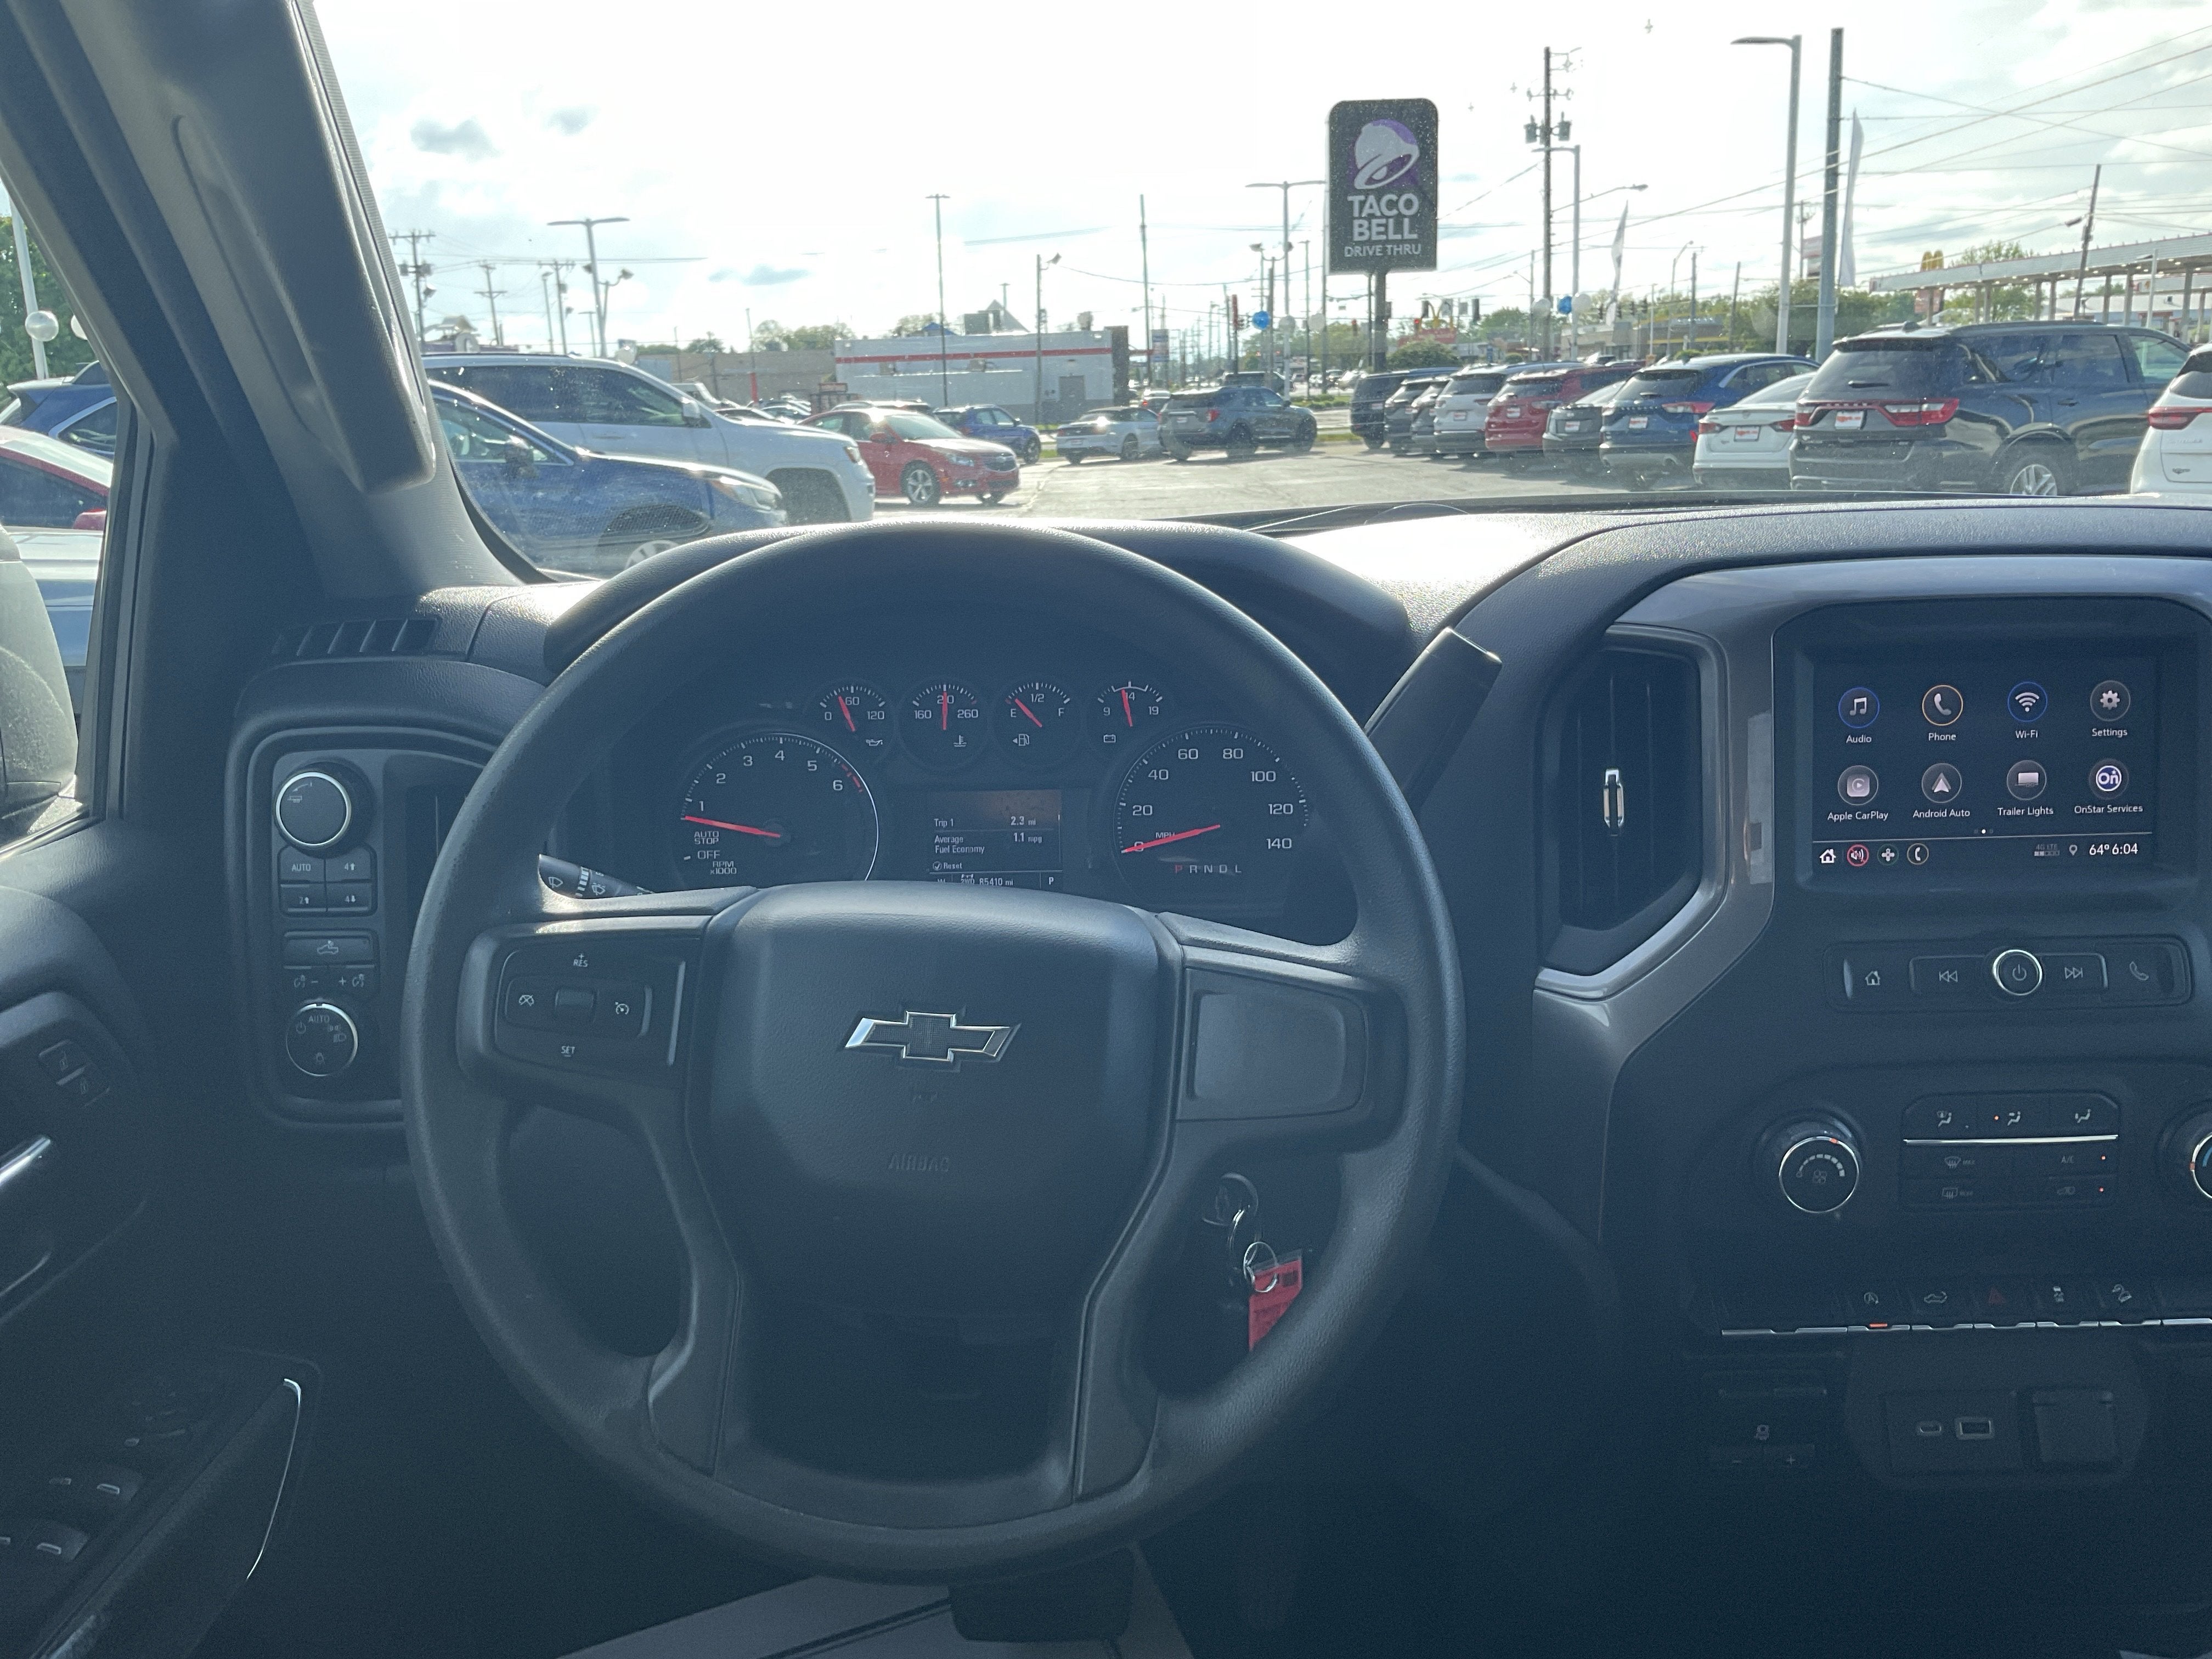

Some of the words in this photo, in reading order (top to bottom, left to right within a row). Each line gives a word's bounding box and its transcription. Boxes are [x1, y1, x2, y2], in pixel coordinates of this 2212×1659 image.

[1347, 193, 1419, 218] TACO
[1353, 218, 1418, 241] BELL
[1345, 246, 1383, 257] DRIVE
[1386, 244, 1421, 256] THRU
[845, 697, 860, 706] 60
[937, 695, 954, 704] 20
[1031, 693, 1045, 703] 1/2
[867, 711, 885, 720] 120
[914, 710, 932, 719] 160
[957, 709, 978, 718] 260
[1010, 709, 1016, 718] E
[1058, 708, 1064, 716] F
[1103, 707, 1110, 716] 9
[1148, 706, 1159, 715] 19
[825, 712, 832, 720] 0
[1928, 732, 1956, 741] Phone
[2015, 730, 2038, 738] Wi-Fi
[2092, 728, 2128, 738] Settings
[1846, 735, 1872, 743] Audio
[775, 750, 785, 761] 4
[1178, 749, 1199, 760] 60
[1222, 748, 1244, 759] 80
[743, 755, 753, 766] 3
[807, 760, 817, 771] 5
[716, 773, 726, 784] 2
[1148, 769, 1169, 780] 40
[1250, 771, 1276, 782] 100
[832, 780, 843, 791] 6
[699, 801, 704, 811] 1
[1132, 805, 1153, 816] 20
[1268, 803, 1294, 815] 120
[1997, 806, 2025, 816] Trailer
[2027, 806, 2054, 816] Lights
[2074, 805, 2104, 814] OnStar
[2107, 804, 2143, 813] Services
[1827, 812, 1853, 822] Apple
[1855, 811, 1889, 821] CarPlay
[1912, 809, 1947, 818] Android
[1949, 809, 1971, 817] Auto
[934, 818, 947, 828] Trip
[950, 818, 954, 827] 1
[1011, 816, 1025, 826] 2.3
[934, 835, 964, 844] Average
[1014, 832, 1025, 842] 1.1
[1266, 838, 1292, 849] 140
[935, 845, 950, 854] Fuel
[952, 845, 985, 854] Economy
[2112, 843, 2138, 855] 6:04
[697, 850, 720, 860] OFF
[291, 863, 311, 872] AUTO
[1175, 865, 1183, 874] P
[1189, 865, 1198, 873] R
[1204, 865, 1213, 873] N
[1219, 865, 1227, 873] D
[1235, 865, 1242, 873] L
[979, 878, 1003, 886] 85410
[1048, 877, 1054, 885] P
[573, 959, 588, 967] RES
[308, 1015, 330, 1024] AUTO
[561, 1046, 575, 1054] SET
[2060, 1155, 2075, 1164] A/C
